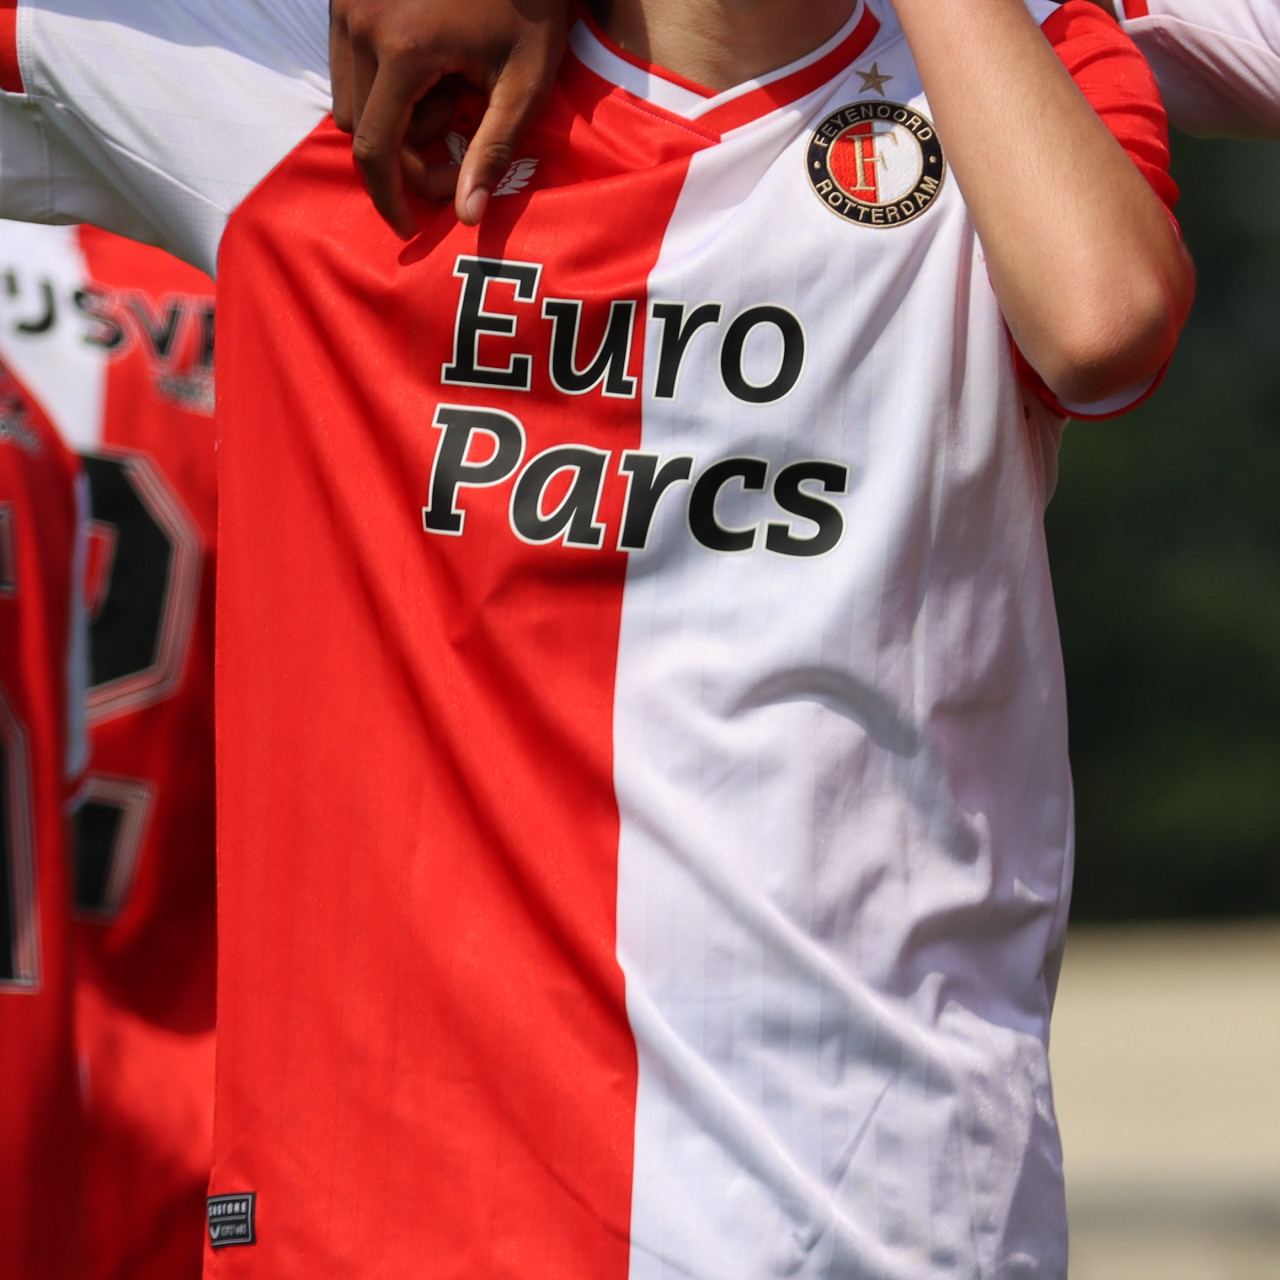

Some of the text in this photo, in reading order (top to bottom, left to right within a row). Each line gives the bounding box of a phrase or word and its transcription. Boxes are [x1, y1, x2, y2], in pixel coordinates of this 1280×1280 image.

[814, 104, 933, 148] FEYENOORD
[816, 174, 940, 224] ROTTERDAM
[440, 254, 806, 407] Euro
[422, 402, 850, 559] Parcs
